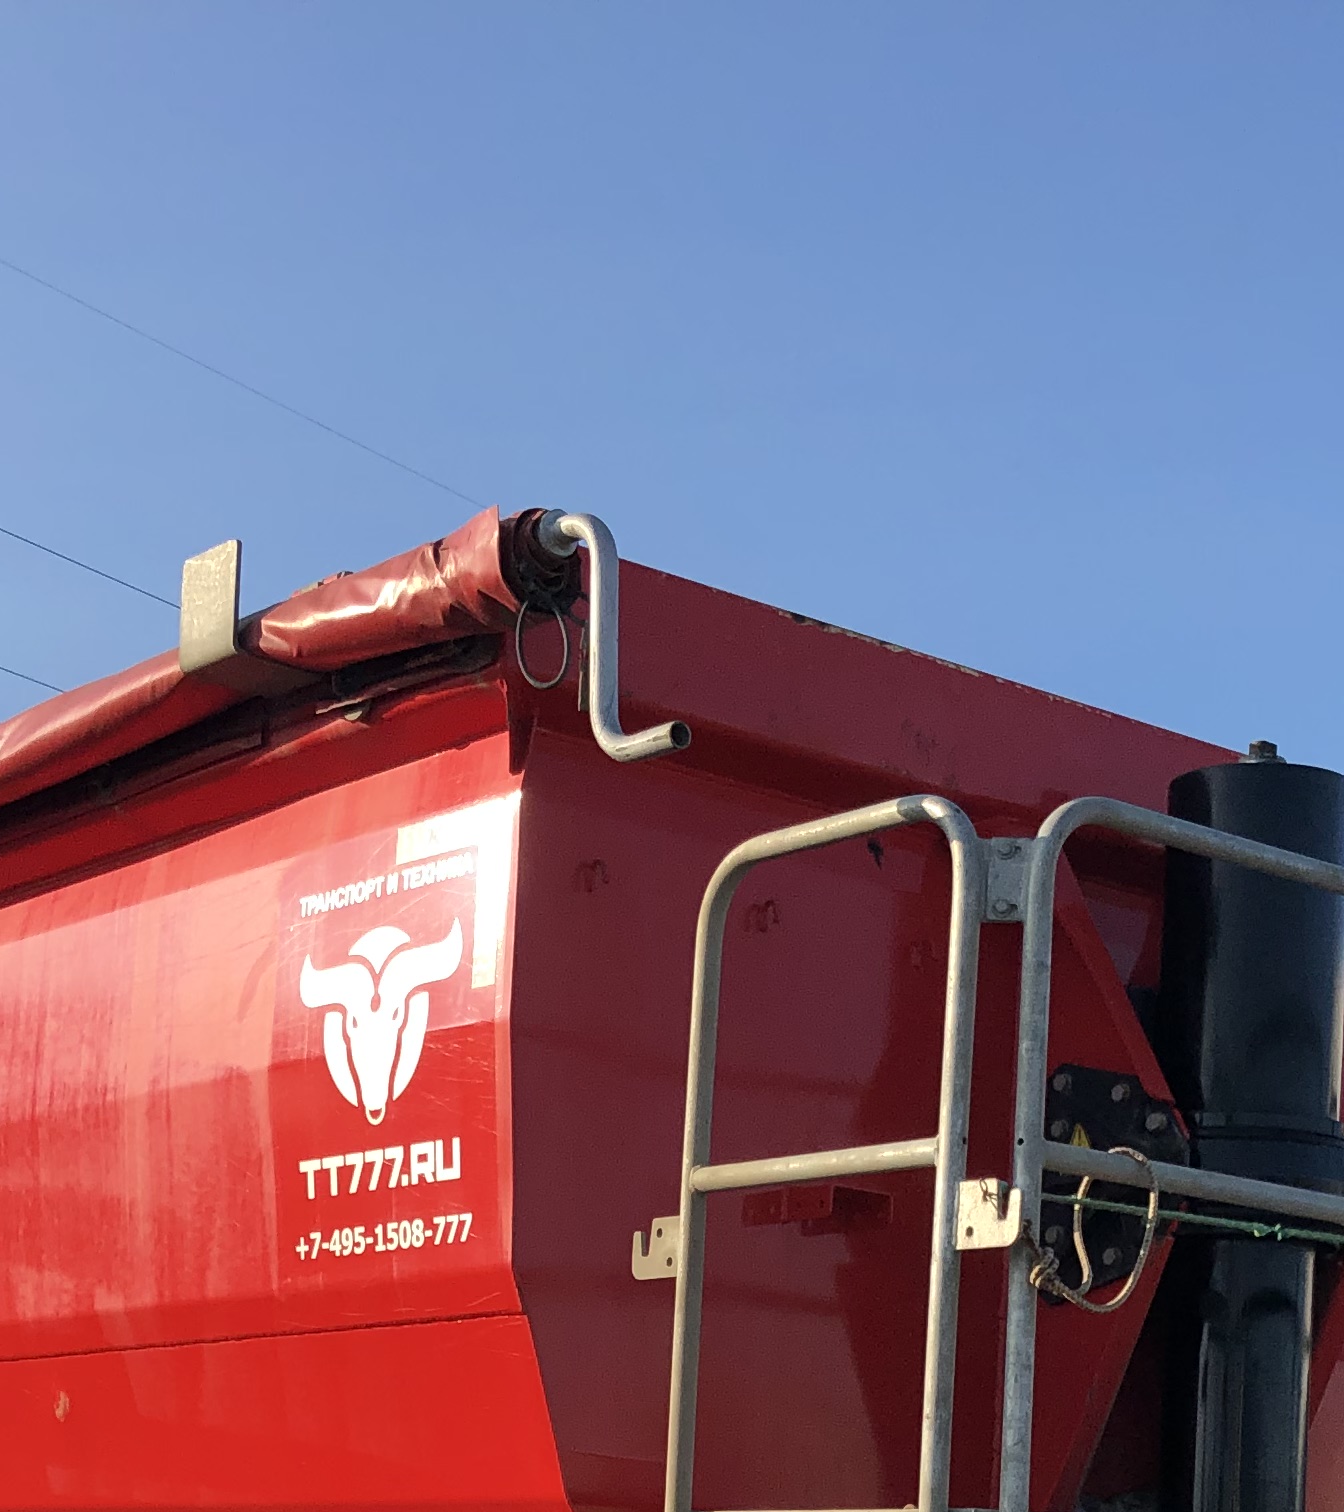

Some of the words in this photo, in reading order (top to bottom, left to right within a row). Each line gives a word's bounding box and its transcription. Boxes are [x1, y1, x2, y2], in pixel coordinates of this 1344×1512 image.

[299, 876, 385, 918] ТРАНСПОРТ
[386, 872, 399, 896] И
[299, 1136, 461, 1200] TT777.RU
[295, 1212, 473, 1260] +7-495-1508-777
